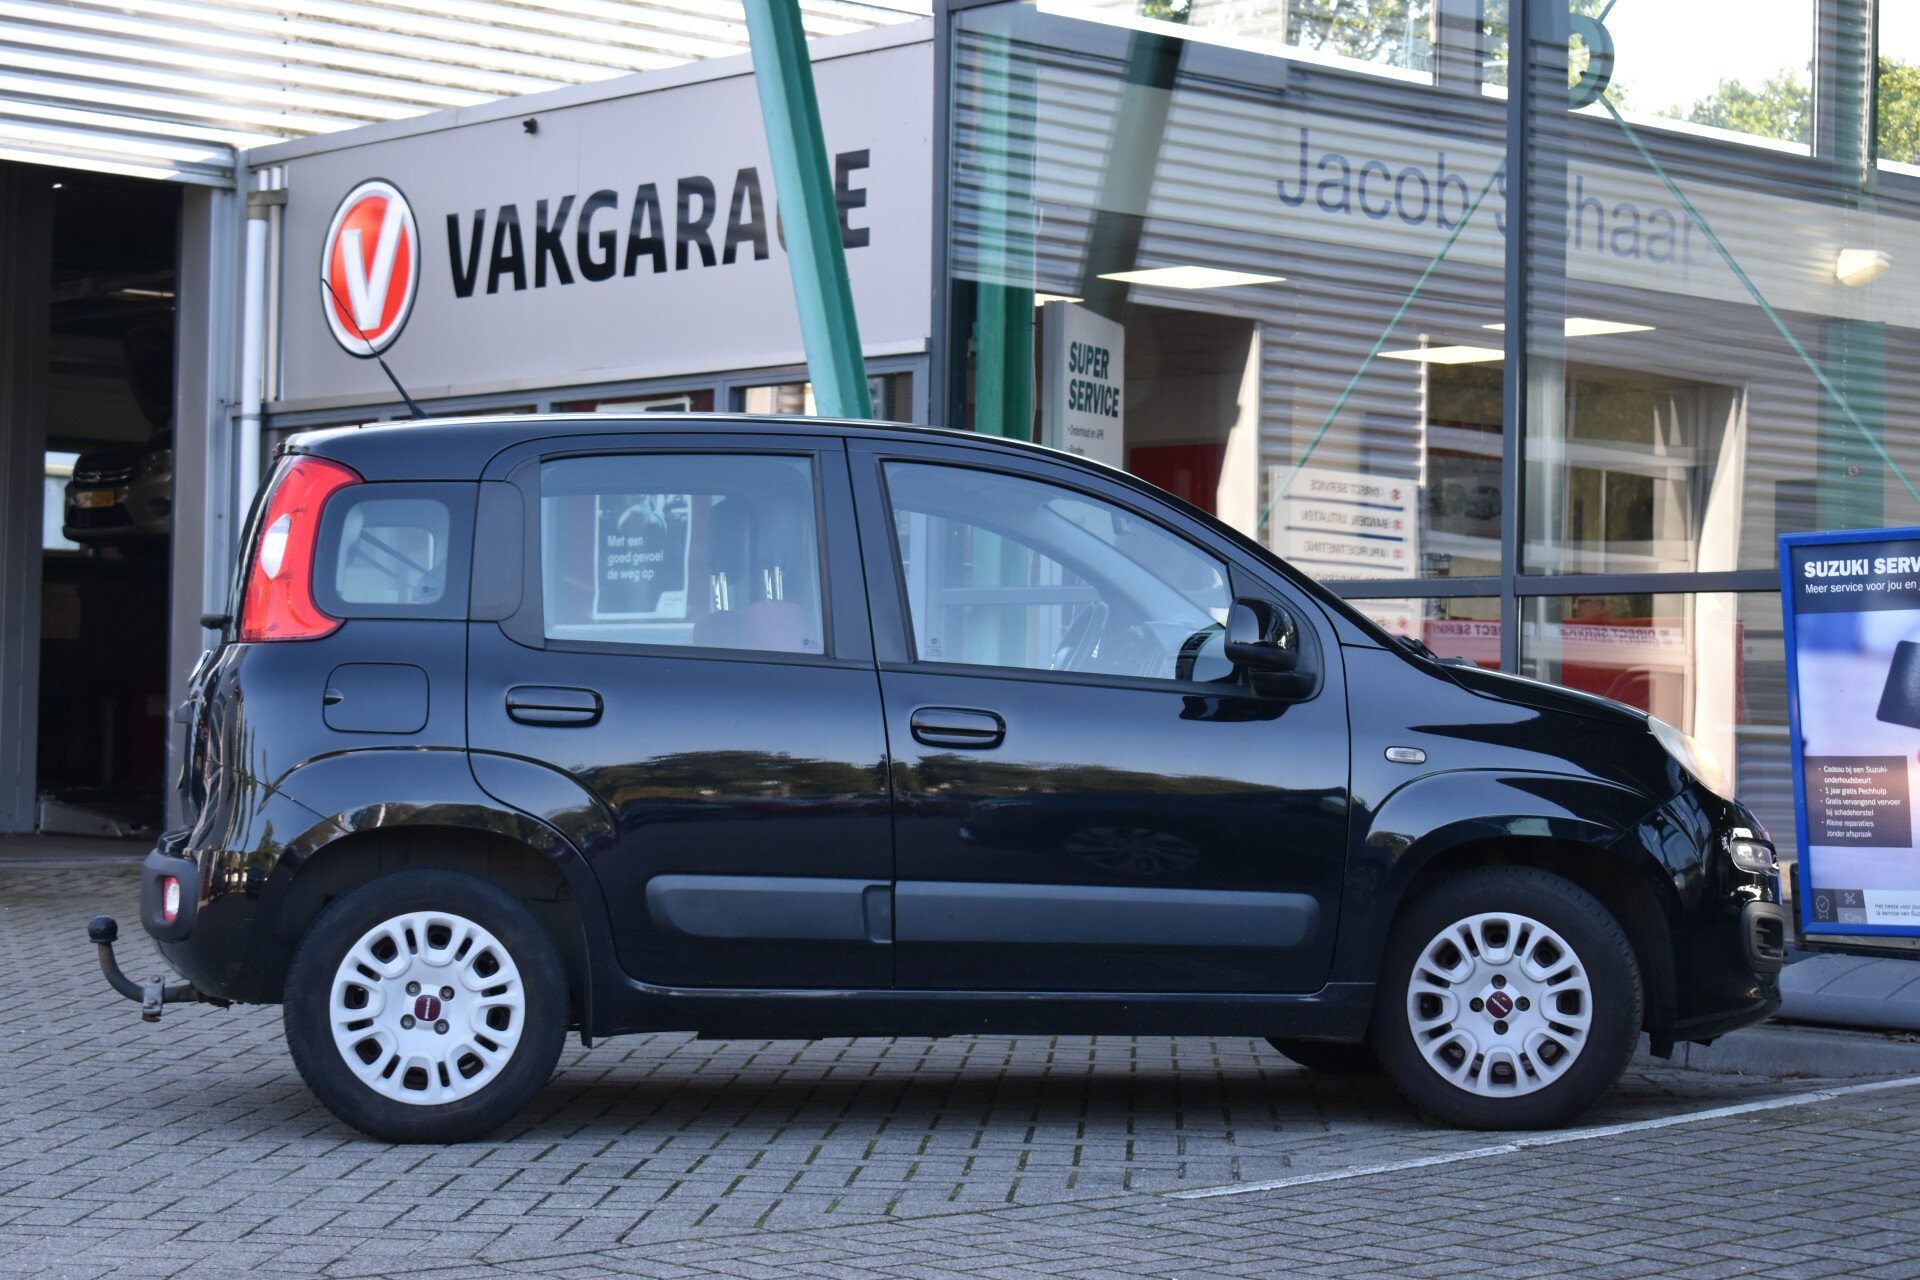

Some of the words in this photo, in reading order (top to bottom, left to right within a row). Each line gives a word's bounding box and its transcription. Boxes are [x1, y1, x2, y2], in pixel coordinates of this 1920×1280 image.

[1277, 127, 1470, 231] Jacob
[1494, 165, 1714, 285] haap
[446, 149, 870, 298] VAKGARAE
[1069, 341, 1109, 380] SUPER
[1068, 378, 1120, 418] SERVICE
[607, 534, 625, 547] Met
[627, 536, 644, 547] een
[608, 551, 631, 567] goed
[633, 549, 664, 566] gevoel
[607, 568, 619, 580] de
[620, 569, 640, 582] weg
[642, 569, 654, 581] op
[1804, 558, 1869, 578] SUZUKI
[1805, 583, 1827, 594] Meer
[1830, 582, 1863, 593] service
[1866, 582, 1886, 591] voor
[1887, 580, 1902, 592] jou
[1905, 581, 1917, 590] en
[1823, 765, 1844, 773] Cadeau
[1845, 765, 1853, 774] bij
[1824, 776, 1871, 784] onderhoudsbeurt
[1842, 788, 1857, 796] gratis
[1858, 787, 1887, 796] Pechhulp
[1842, 799, 1876, 807] vervangend
[1825, 808, 1833, 816] bij
[1844, 820, 1875, 828] reparaties
